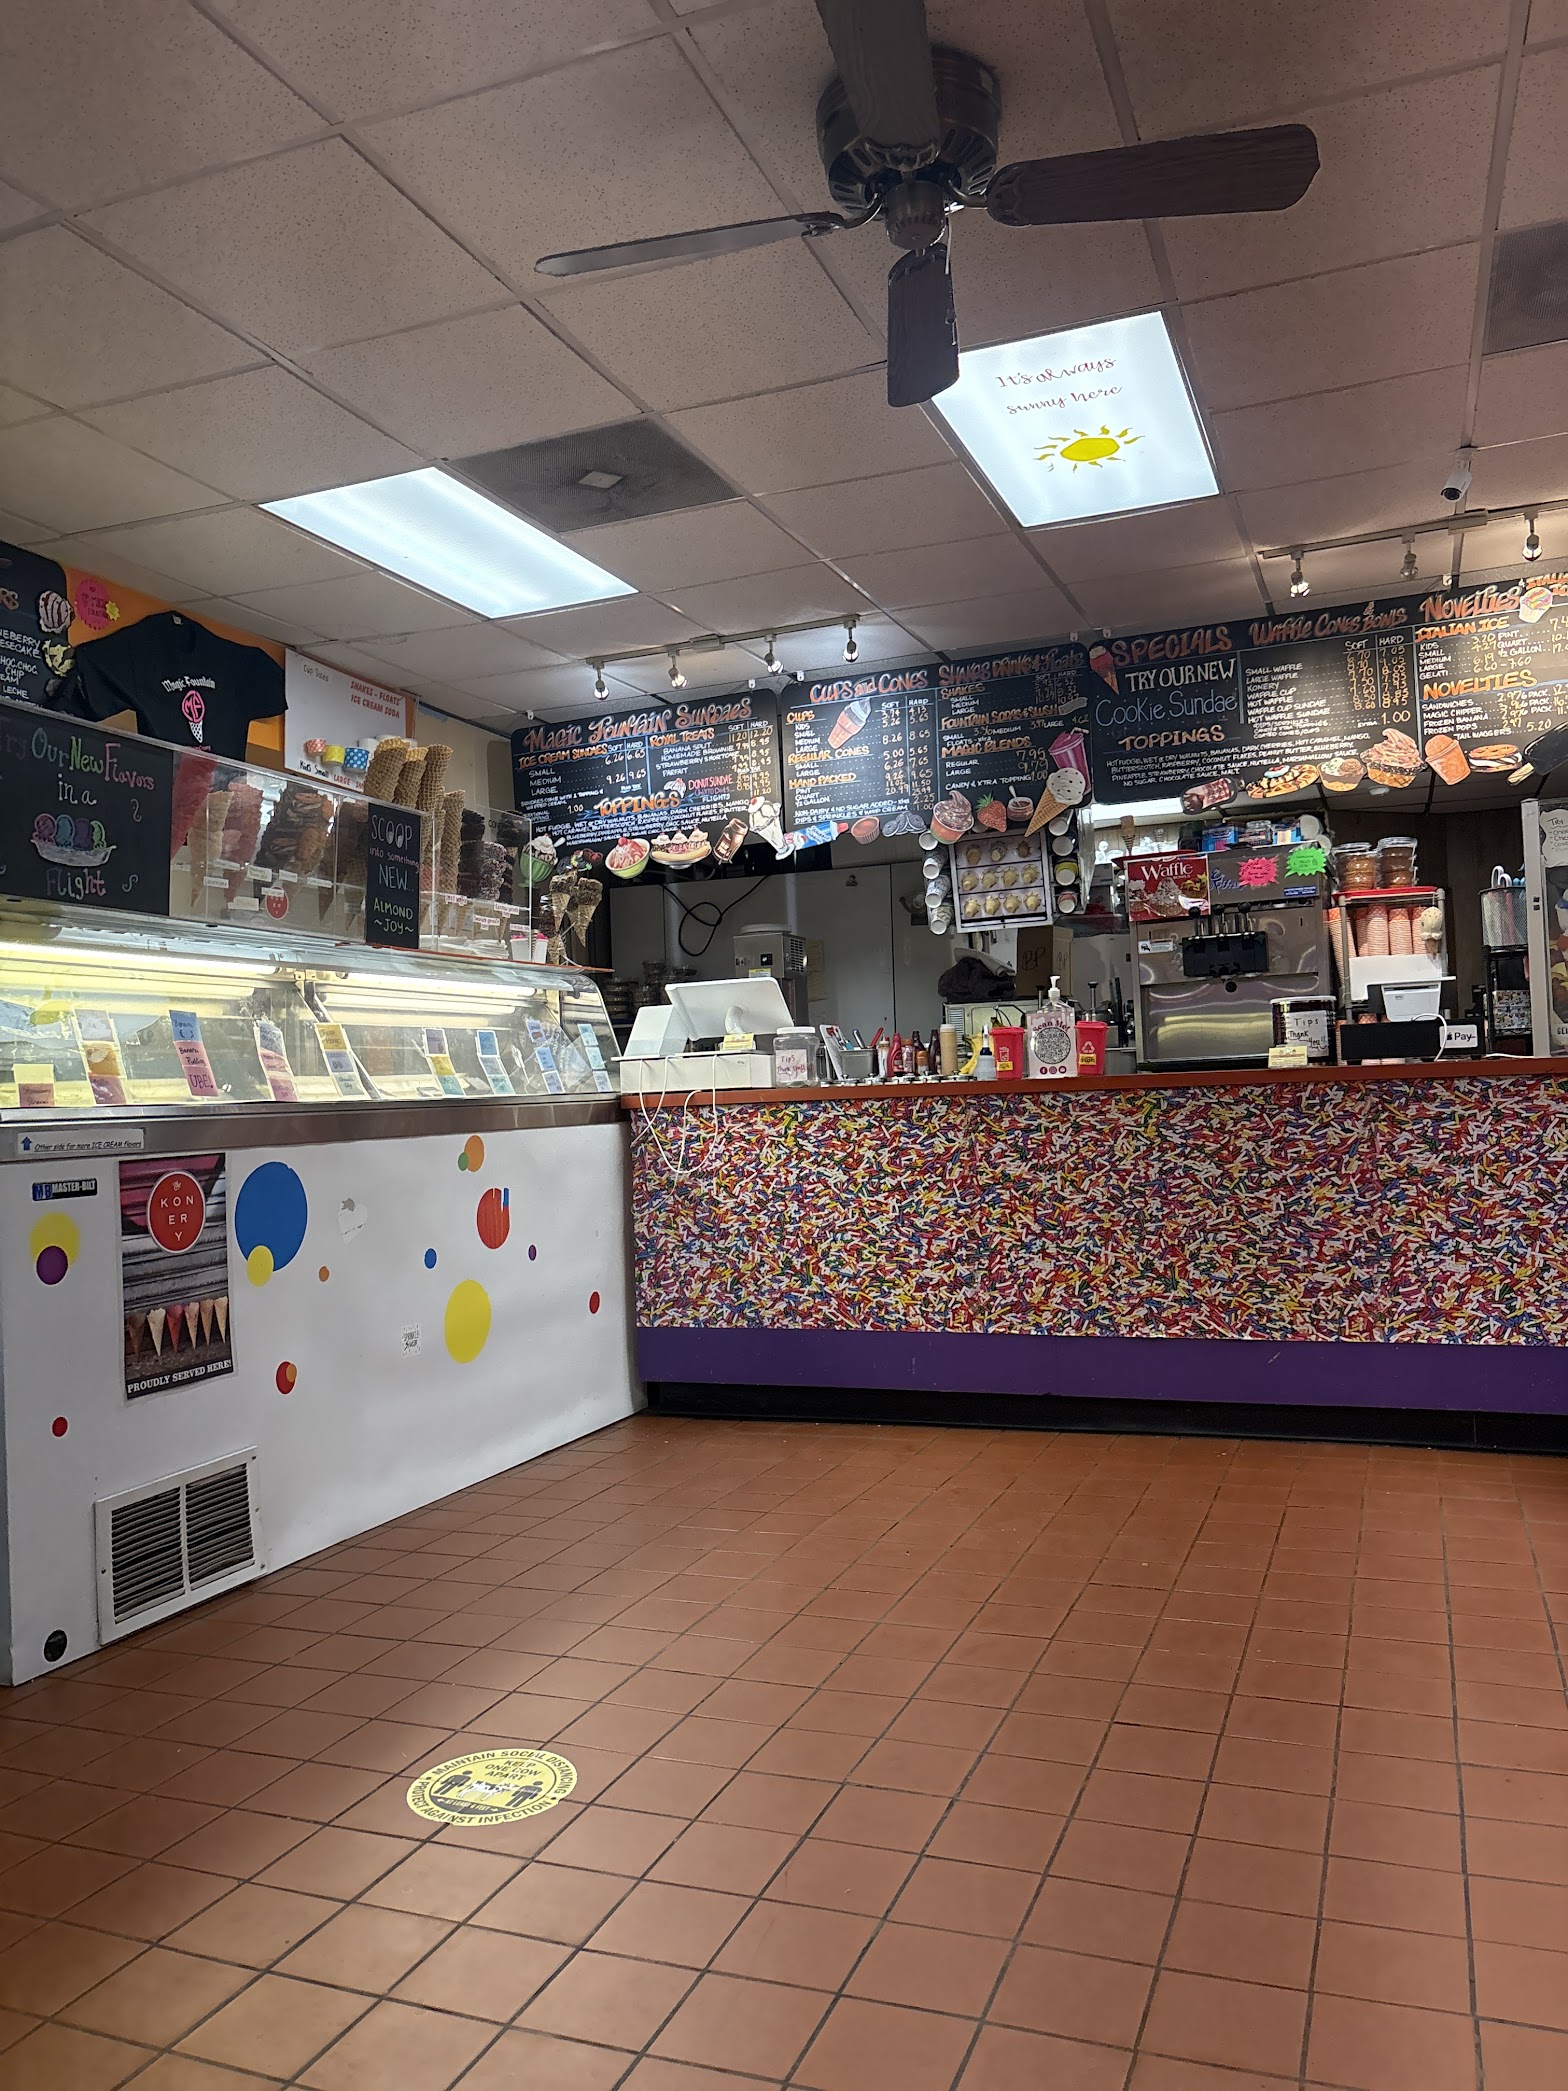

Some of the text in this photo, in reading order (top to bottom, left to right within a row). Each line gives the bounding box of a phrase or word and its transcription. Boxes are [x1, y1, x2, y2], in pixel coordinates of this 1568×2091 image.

[995, 357, 1117, 387] It's always
[1007, 385, 1123, 415] sunny here
[1415, 615, 1510, 643] ITALIAN ICE
[1498, 629, 1520, 641] PINT
[1111, 625, 1233, 667] SPECIALS
[1345, 635, 1405, 651] SOFT HARD
[1420, 642, 1440, 651] KIDS
[1497, 639, 1528, 649] QUART
[1418, 650, 1445, 659] SMALL
[1509, 645, 1543, 658] GALLON
[1419, 656, 1452, 666] MEDIUM
[1419, 663, 1446, 673] LARGE
[5, 666, 25, 679] CHIP
[1125, 658, 1237, 692] TRY OUR NEW
[1245, 662, 1304, 677] SMALL WAFFLE
[1419, 670, 1449, 681] GELATI
[161, 675, 216, 693] Magic Fountain
[1246, 672, 1299, 685] LARGE WAFFLE
[1423, 668, 1538, 701] NOVELTIES
[2, 684, 30, 700] LECHE
[350, 680, 400, 706] SHAKES FLOATS
[808, 669, 929, 704] CUPS CONES
[940, 682, 986, 700] SHAKES
[351, 694, 400, 719] ICE CREAM SODA
[881, 701, 900, 710] SOFT
[951, 700, 980, 710] MEDIUM
[1169, 688, 1238, 718] Sundae
[1421, 699, 1475, 711] SANDWICHES
[786, 710, 816, 724] CUPS
[951, 706, 976, 716] LARGE
[1381, 710, 1411, 725] 1.00
[1423, 706, 1484, 720] MAGIC CHIPPER
[794, 723, 811, 731] KIDS
[941, 713, 990, 731] FOUNTAIN
[992, 720, 1064, 735] MEDIUM LARGE
[1423, 713, 1489, 728] FROZEN BANANA
[794, 730, 816, 739] SMALL
[1423, 722, 1479, 736] FROZEN POPS
[1453, 732, 1471, 741] TAIL
[1471, 728, 1513, 738] WAGGERS
[649, 727, 716, 748] ROYAL TREATS
[984, 736, 1033, 750] BLENDS
[1118, 725, 1226, 751] TOPPINGS
[31, 727, 69, 767] Our
[69, 735, 105, 775] New
[607, 744, 624, 752] SOFT
[662, 745, 692, 756] BANANA
[795, 745, 819, 754] LARGE
[834, 745, 870, 758] CONES
[537, 750, 571, 765] CREAM
[655, 756, 703, 770] STRAWBERRY
[661, 750, 701, 762] HOMEMADE
[794, 762, 820, 771] SMALL
[945, 758, 980, 769] REGULAR
[333, 774, 351, 785] LARGE
[528, 767, 556, 778] SMALL
[662, 767, 689, 778] PARFAIT
[796, 769, 821, 778] LARGE
[945, 768, 972, 777] LARGE
[529, 775, 562, 787] MEDIUM
[788, 772, 857, 790] HAND PACKED
[945, 774, 1032, 791] CANDY TOPPING
[57, 772, 98, 806] in a
[531, 786, 558, 796] LARGE
[593, 791, 681, 817] TOPPINGS
[702, 793, 731, 803] FLIGHTS
[371, 814, 413, 850] SCOOP
[369, 847, 384, 859] into
[1141, 861, 1194, 881] Waffle
[46, 867, 107, 900] Flight
[1032, 1020, 1053, 1033] Scan
[1293, 1017, 1319, 1031] Tips
[1453, 1032, 1472, 1042] Pay
[189, 1073, 214, 1090] UBE!
[52, 1180, 96, 1193] MASTER-BILT
[127, 1358, 233, 1394] PROUDLY SERVED HERE!
[484, 1763, 542, 1777] ONE COW
[504, 1759, 537, 1768] KEEP
[431, 1750, 574, 1794] MAINTAIN SOCIAL DISTANCING
[484, 1770, 527, 1781] APART
[411, 1780, 552, 1824] PROTECT AGAINST INFECTION
